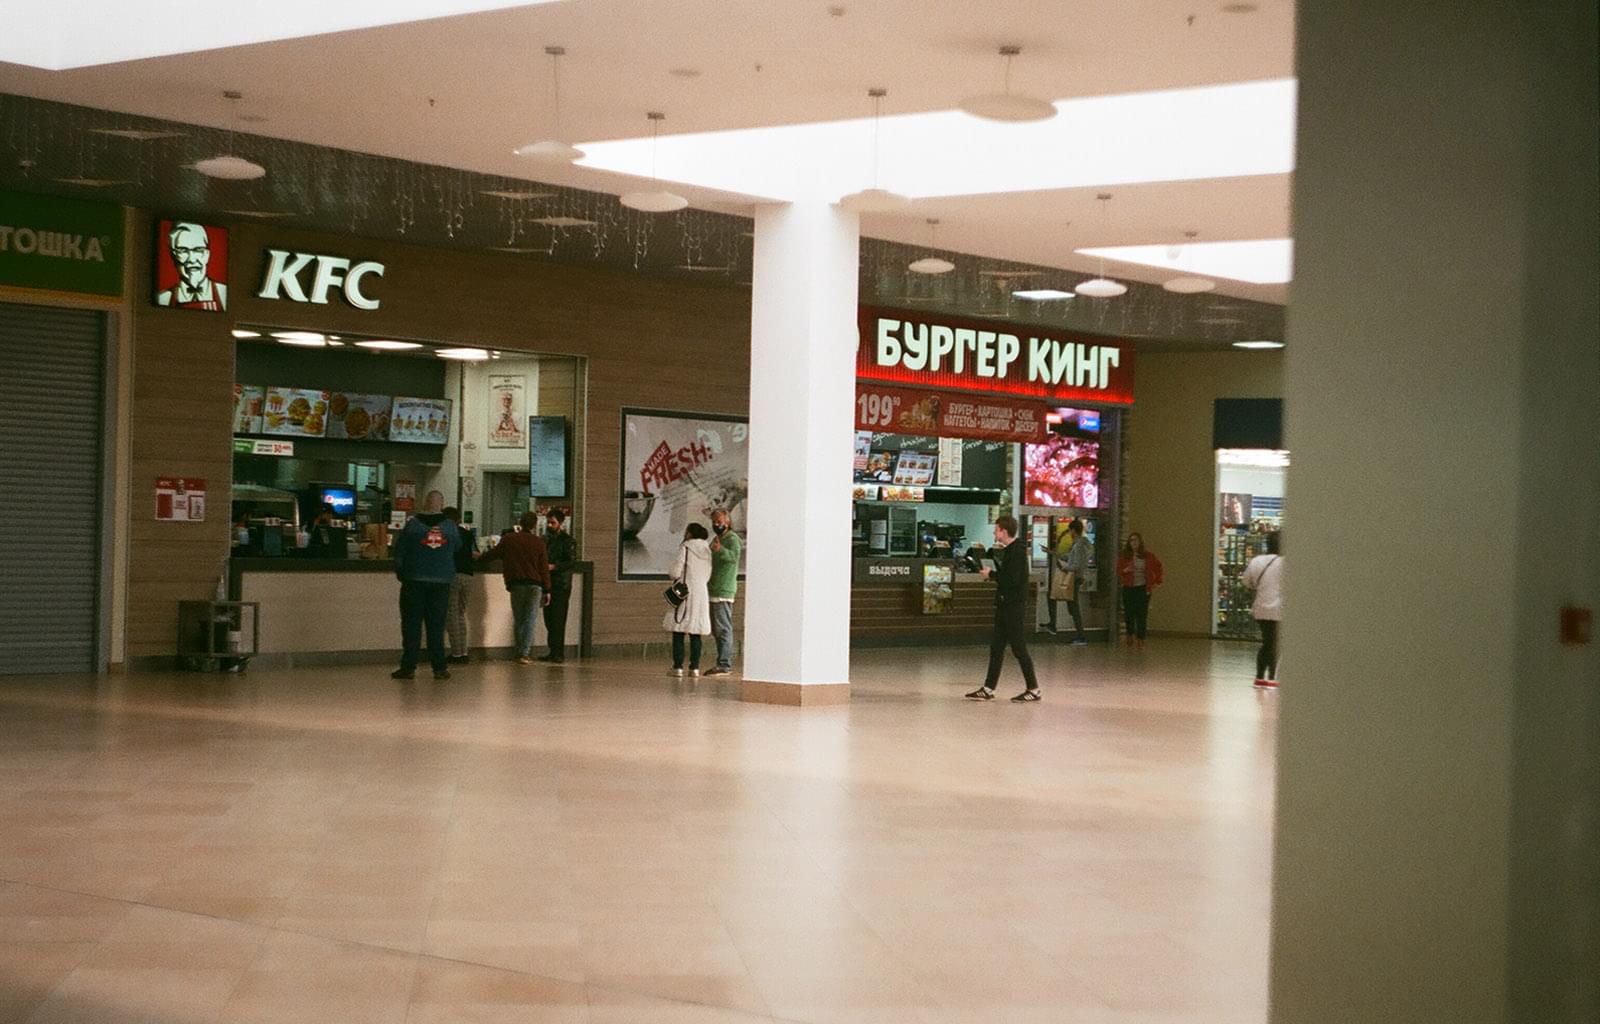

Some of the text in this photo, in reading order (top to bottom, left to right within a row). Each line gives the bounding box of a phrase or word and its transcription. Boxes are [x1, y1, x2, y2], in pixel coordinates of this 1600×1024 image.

[258, 249, 385, 310] KFC
[878, 317, 1120, 389] БУРГЕР КИНГ
[858, 393, 893, 426] 199
[646, 445, 670, 471] MADE
[869, 565, 910, 577] выдача
